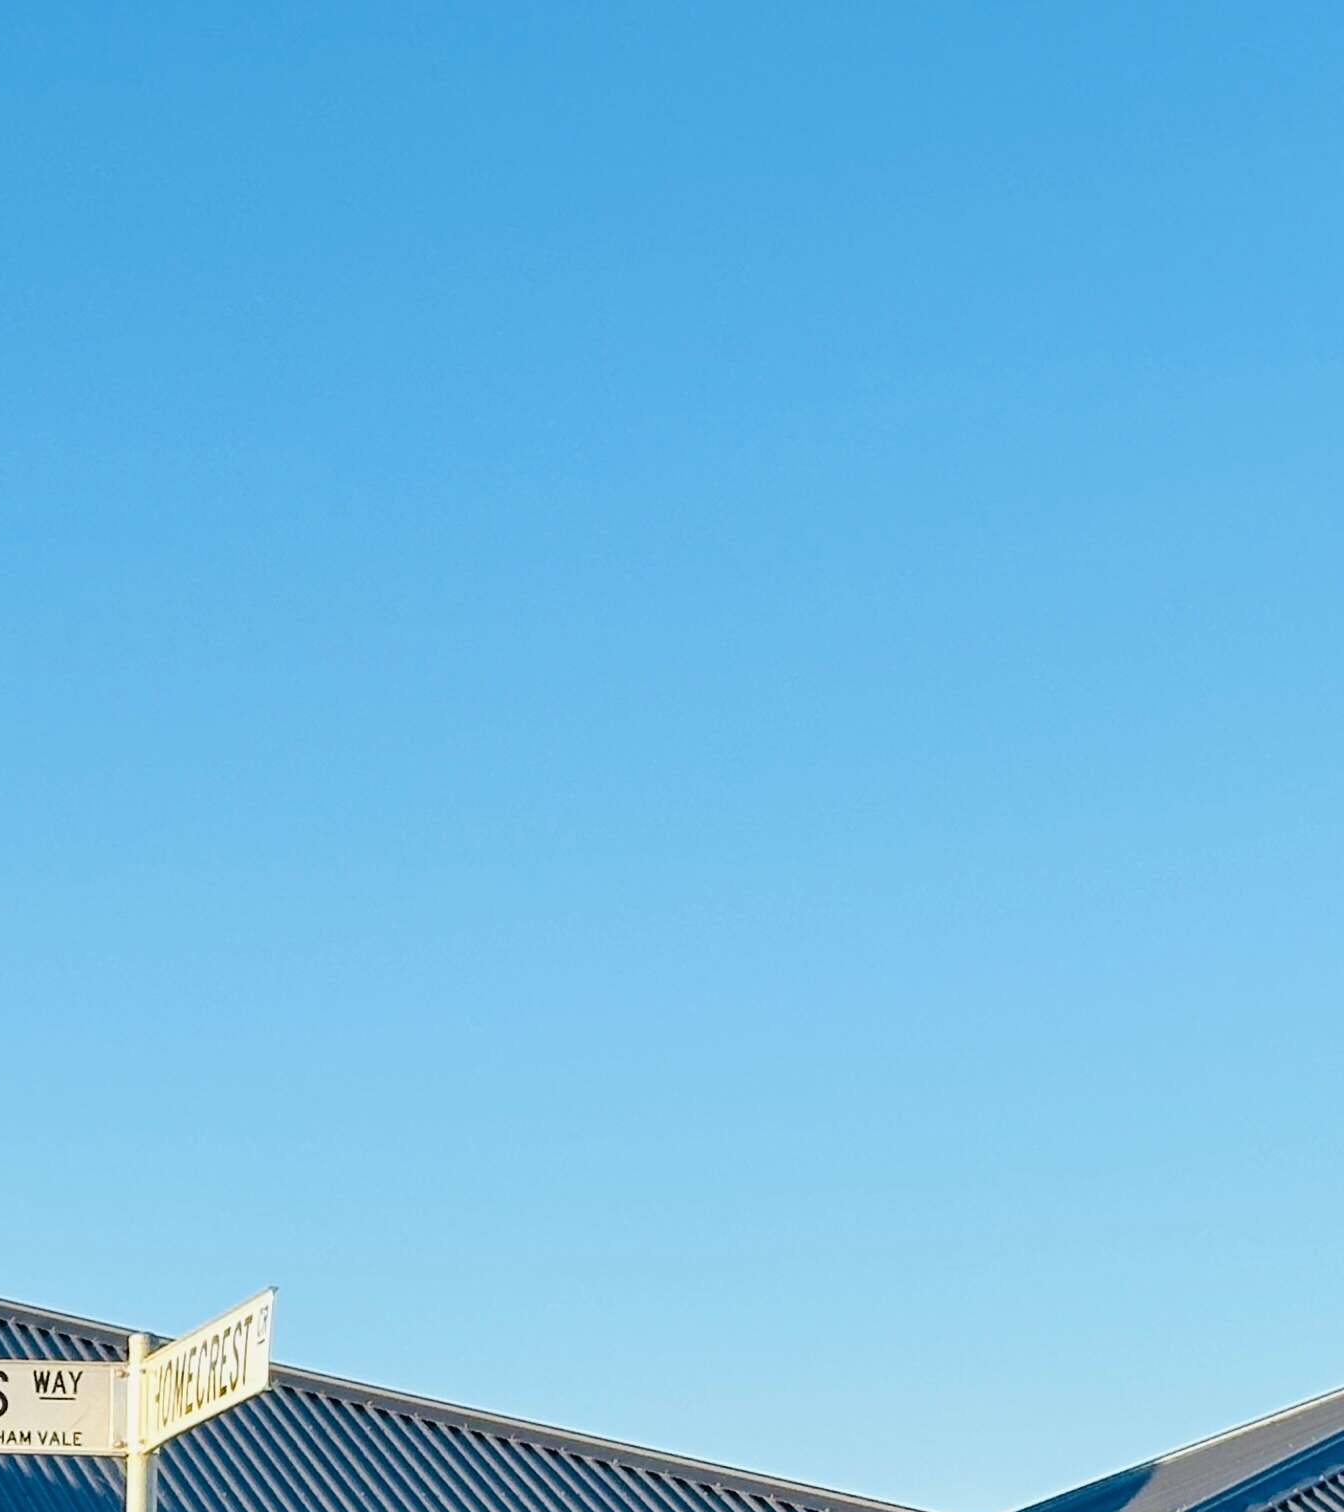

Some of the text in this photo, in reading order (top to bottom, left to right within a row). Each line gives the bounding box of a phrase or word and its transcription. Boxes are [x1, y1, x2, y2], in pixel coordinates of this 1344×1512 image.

[33, 1369, 83, 1395] WAY
[153, 1314, 253, 1433] HOMECREST
[37, 1430, 83, 1447] VALE
